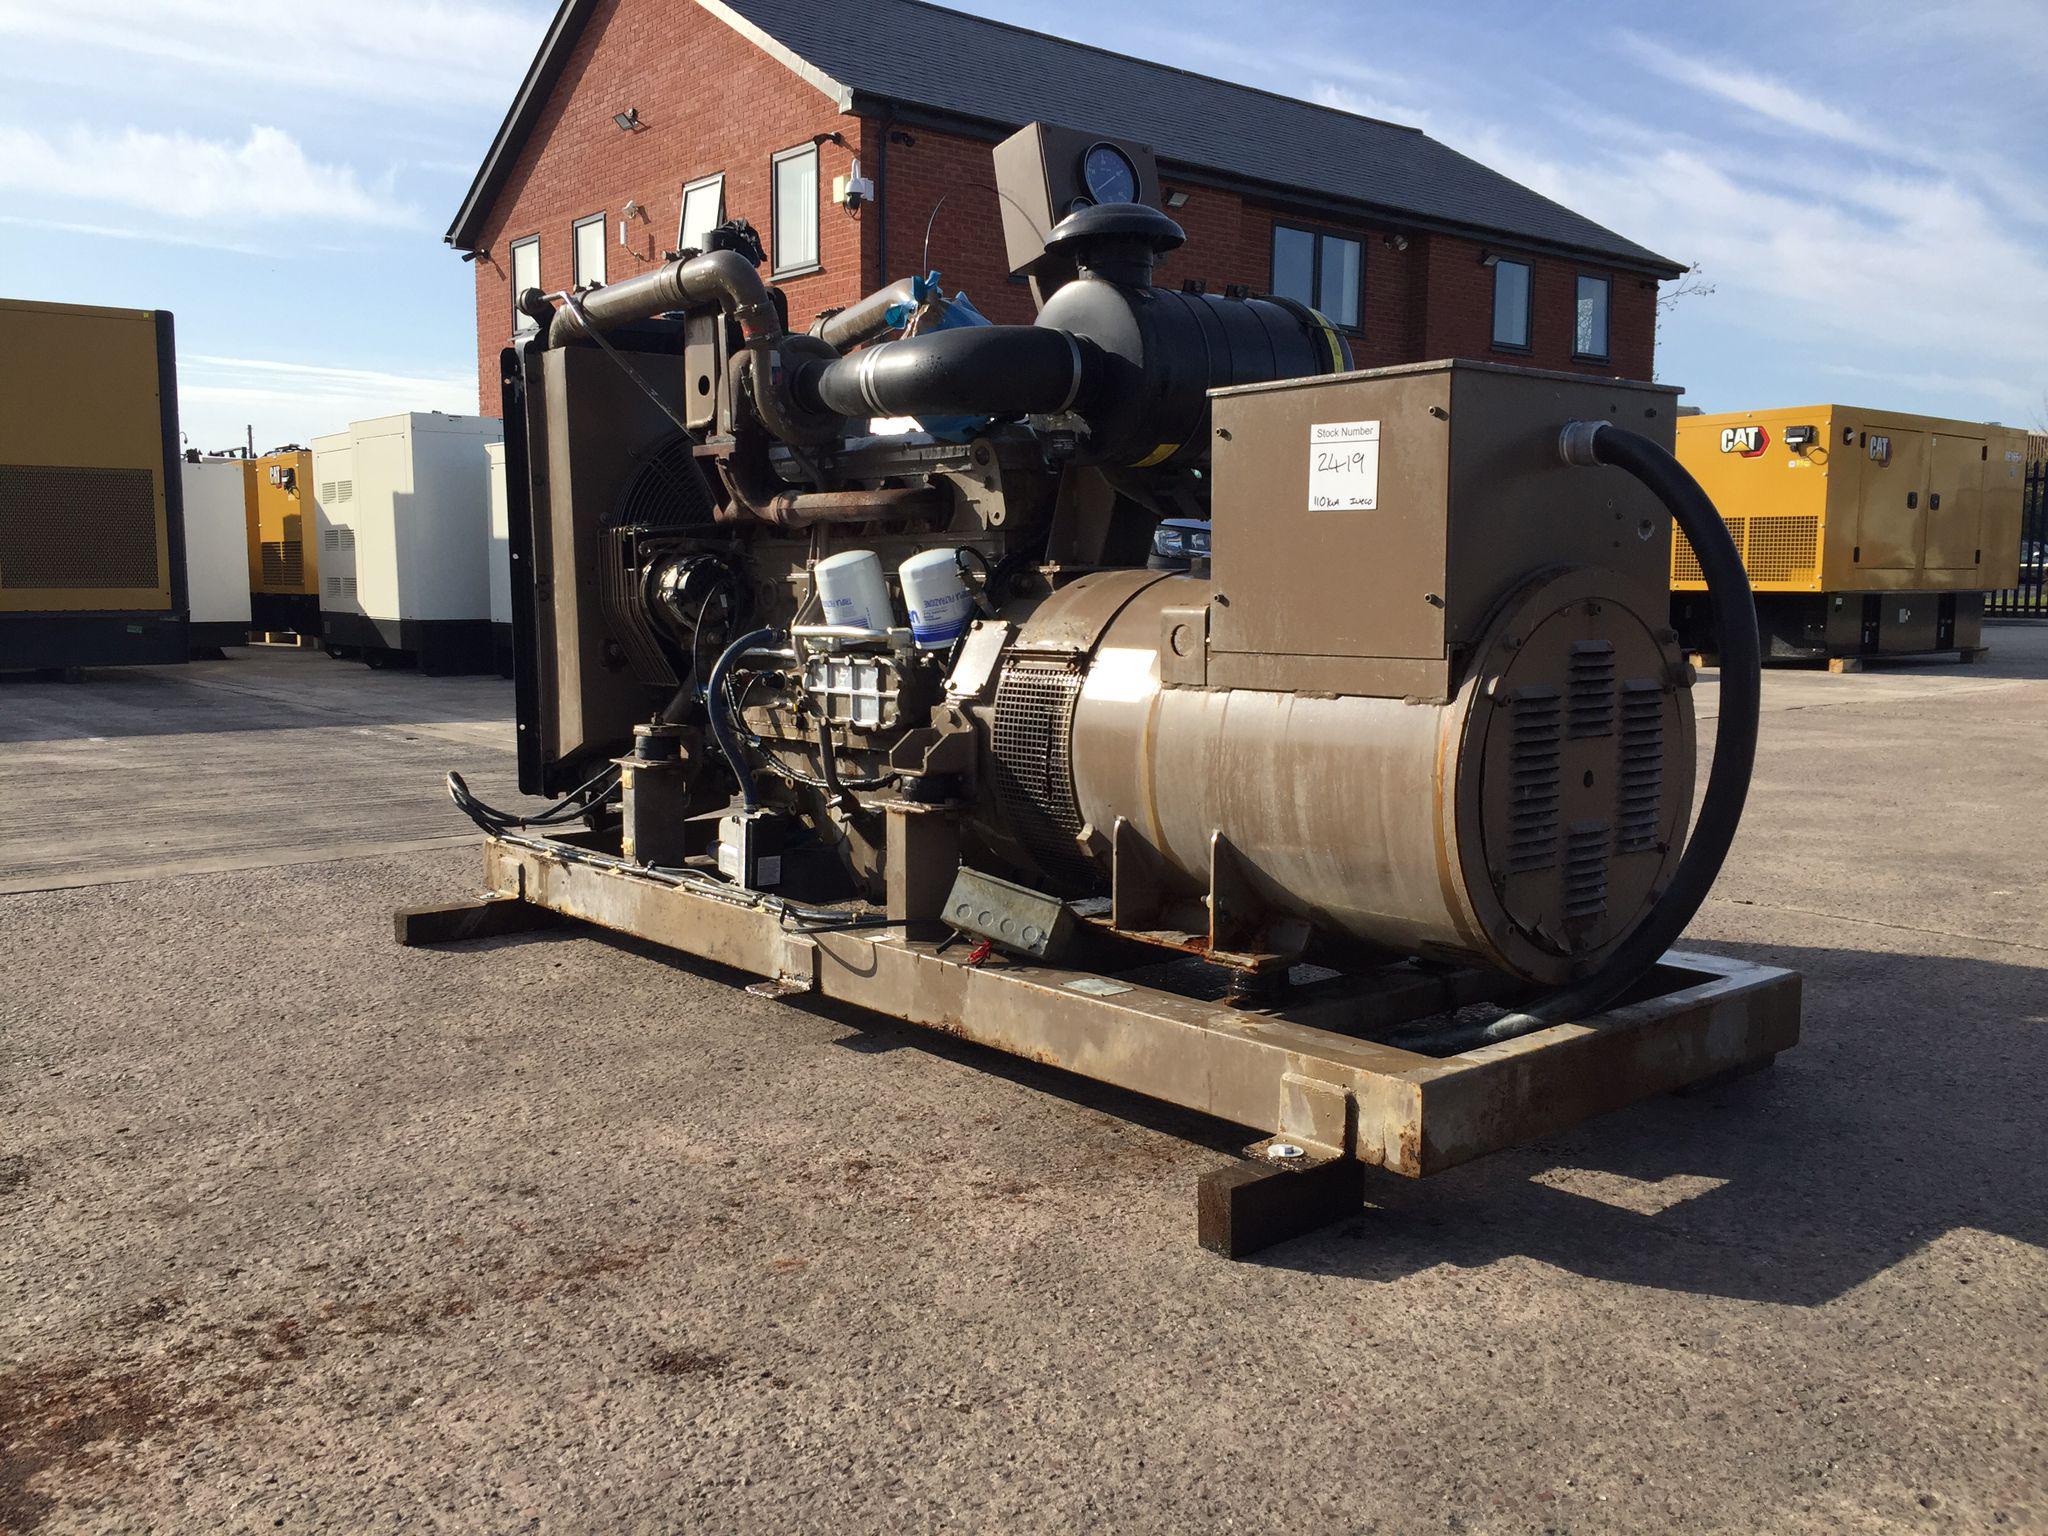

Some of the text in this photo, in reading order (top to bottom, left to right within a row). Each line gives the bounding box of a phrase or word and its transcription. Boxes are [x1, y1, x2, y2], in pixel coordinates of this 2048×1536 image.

[1317, 427, 1373, 438] Stock Number
[1721, 427, 1759, 453] CAT
[1870, 435, 1889, 460] CAT
[1318, 452, 1365, 474] 2419
